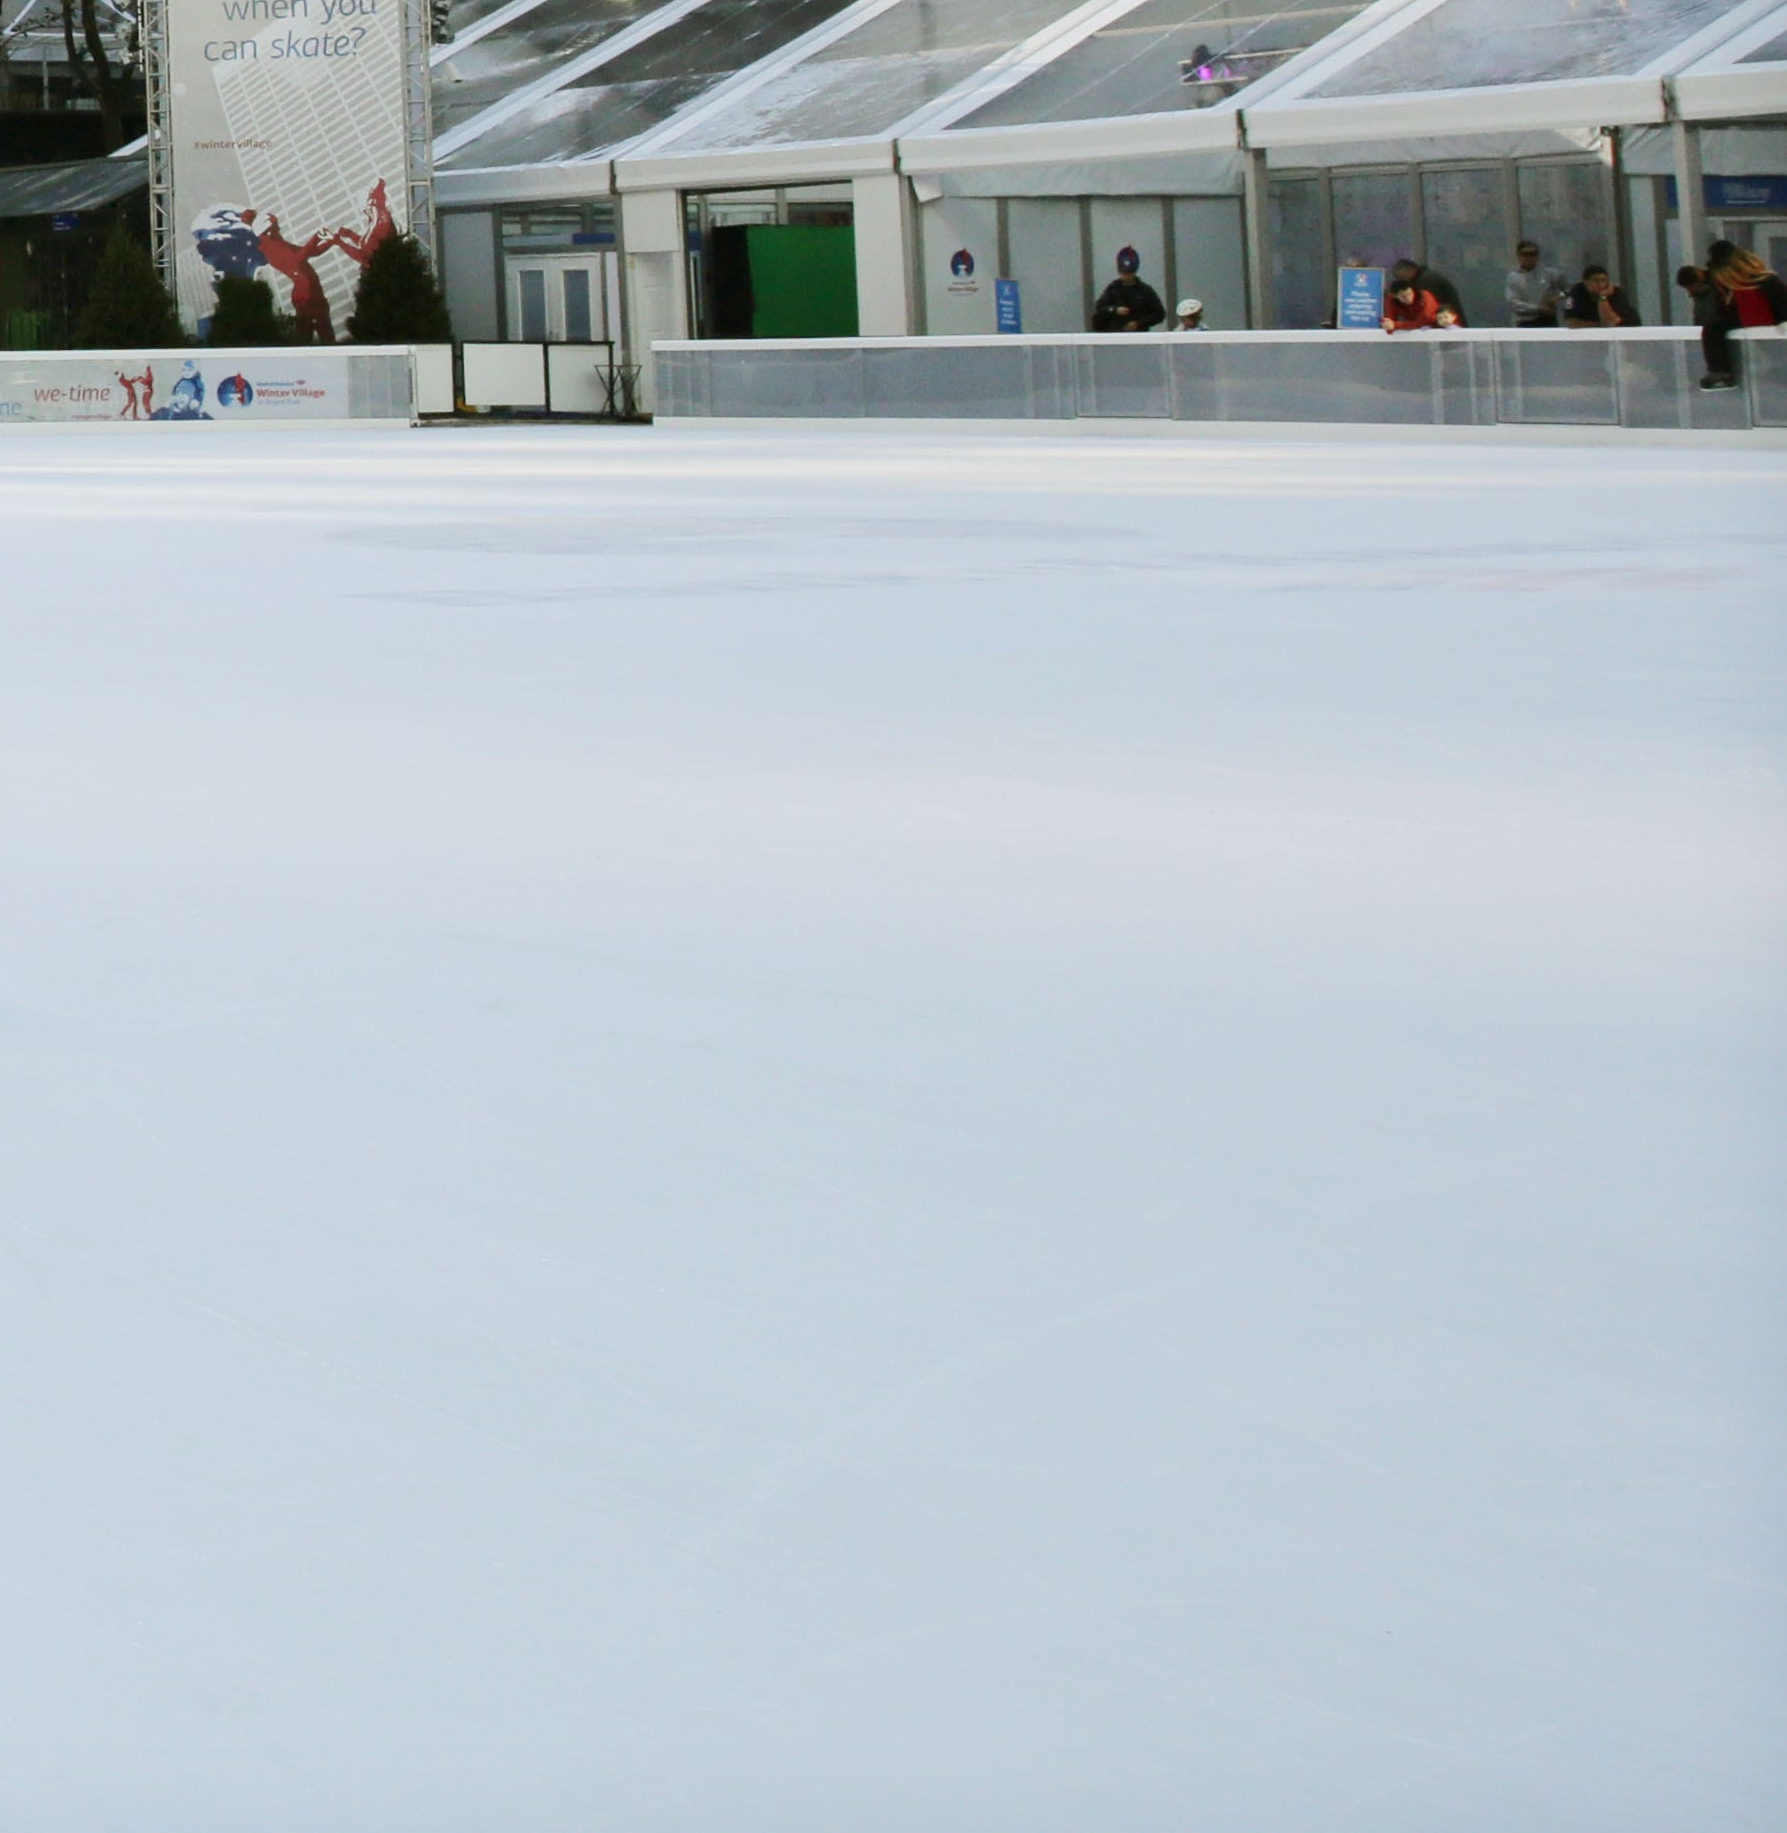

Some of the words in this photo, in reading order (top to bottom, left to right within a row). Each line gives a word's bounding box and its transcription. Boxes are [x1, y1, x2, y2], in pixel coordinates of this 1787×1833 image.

[203, 39, 258, 62] can
[270, 27, 366, 60] skate?
[33, 385, 110, 402] we-time
[256, 388, 291, 398] Winter
[292, 388, 326, 399] Village
